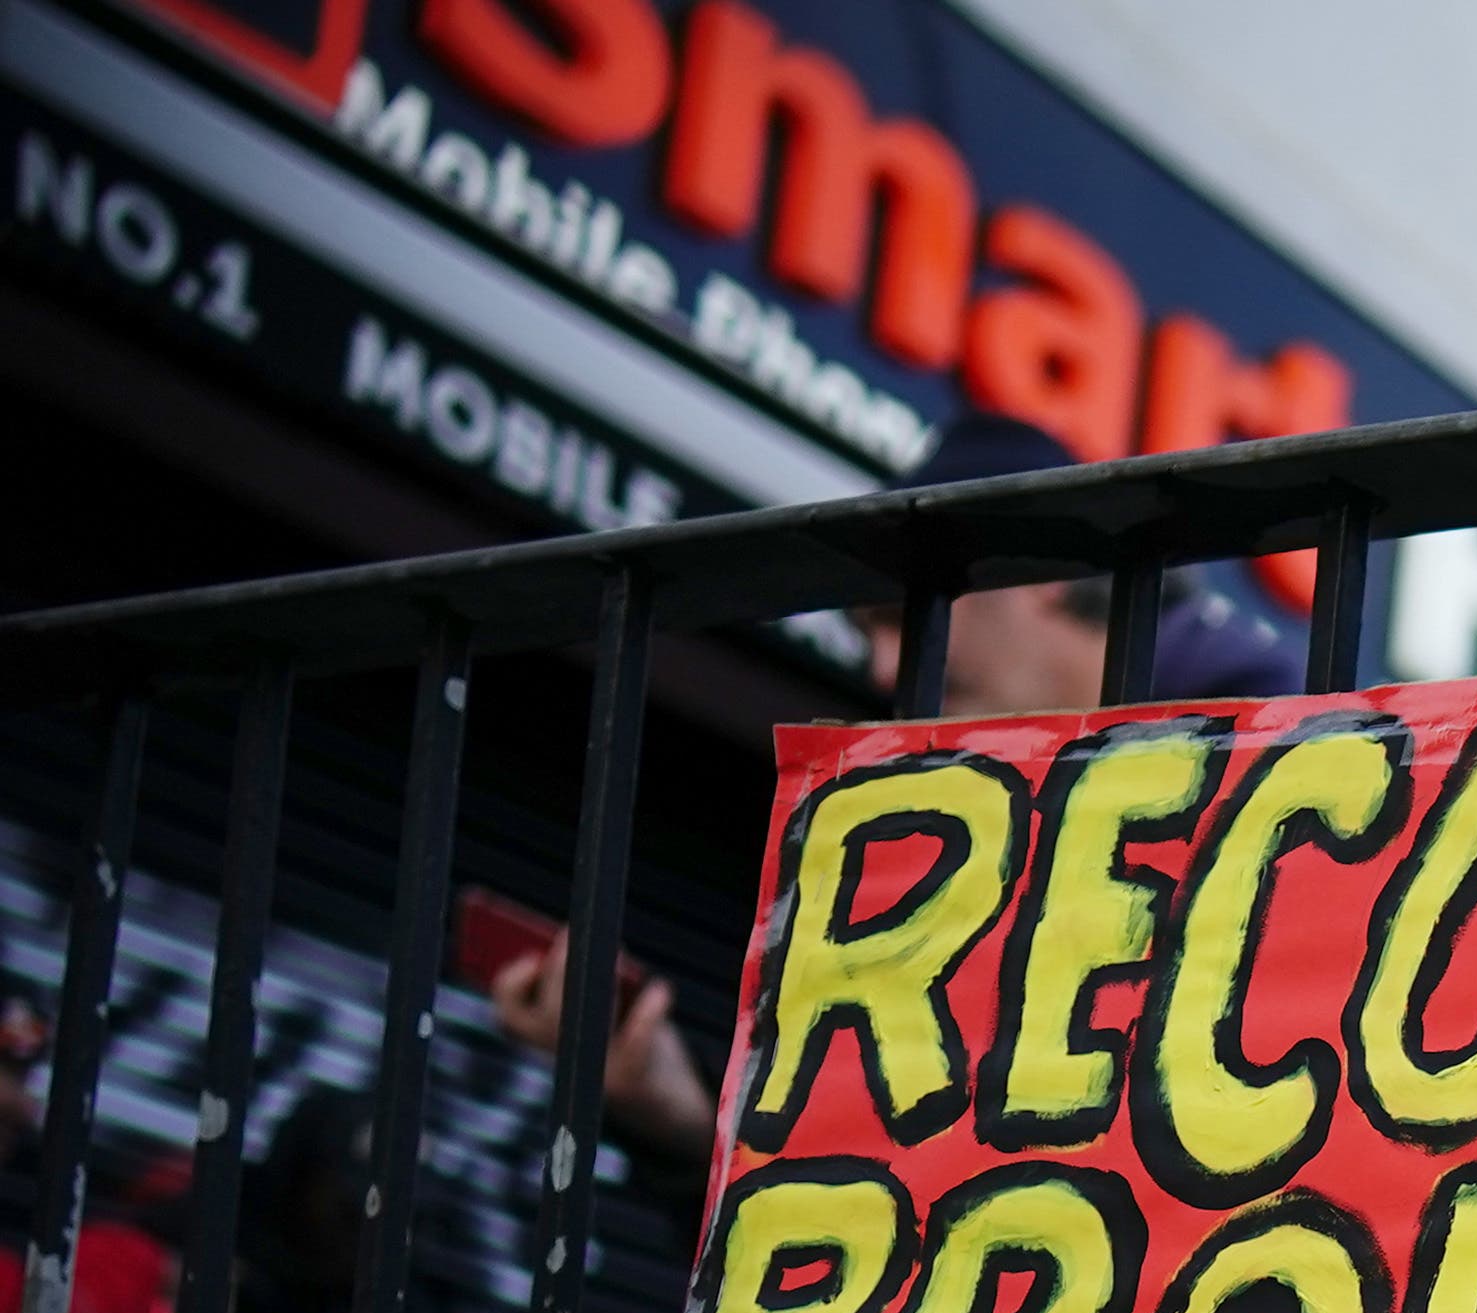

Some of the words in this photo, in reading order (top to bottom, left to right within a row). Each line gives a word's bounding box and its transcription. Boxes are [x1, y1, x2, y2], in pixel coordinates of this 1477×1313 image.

[14, 130, 260, 342] NO.1
[336, 55, 679, 314] Mobile
[694, 268, 942, 478] Phon
